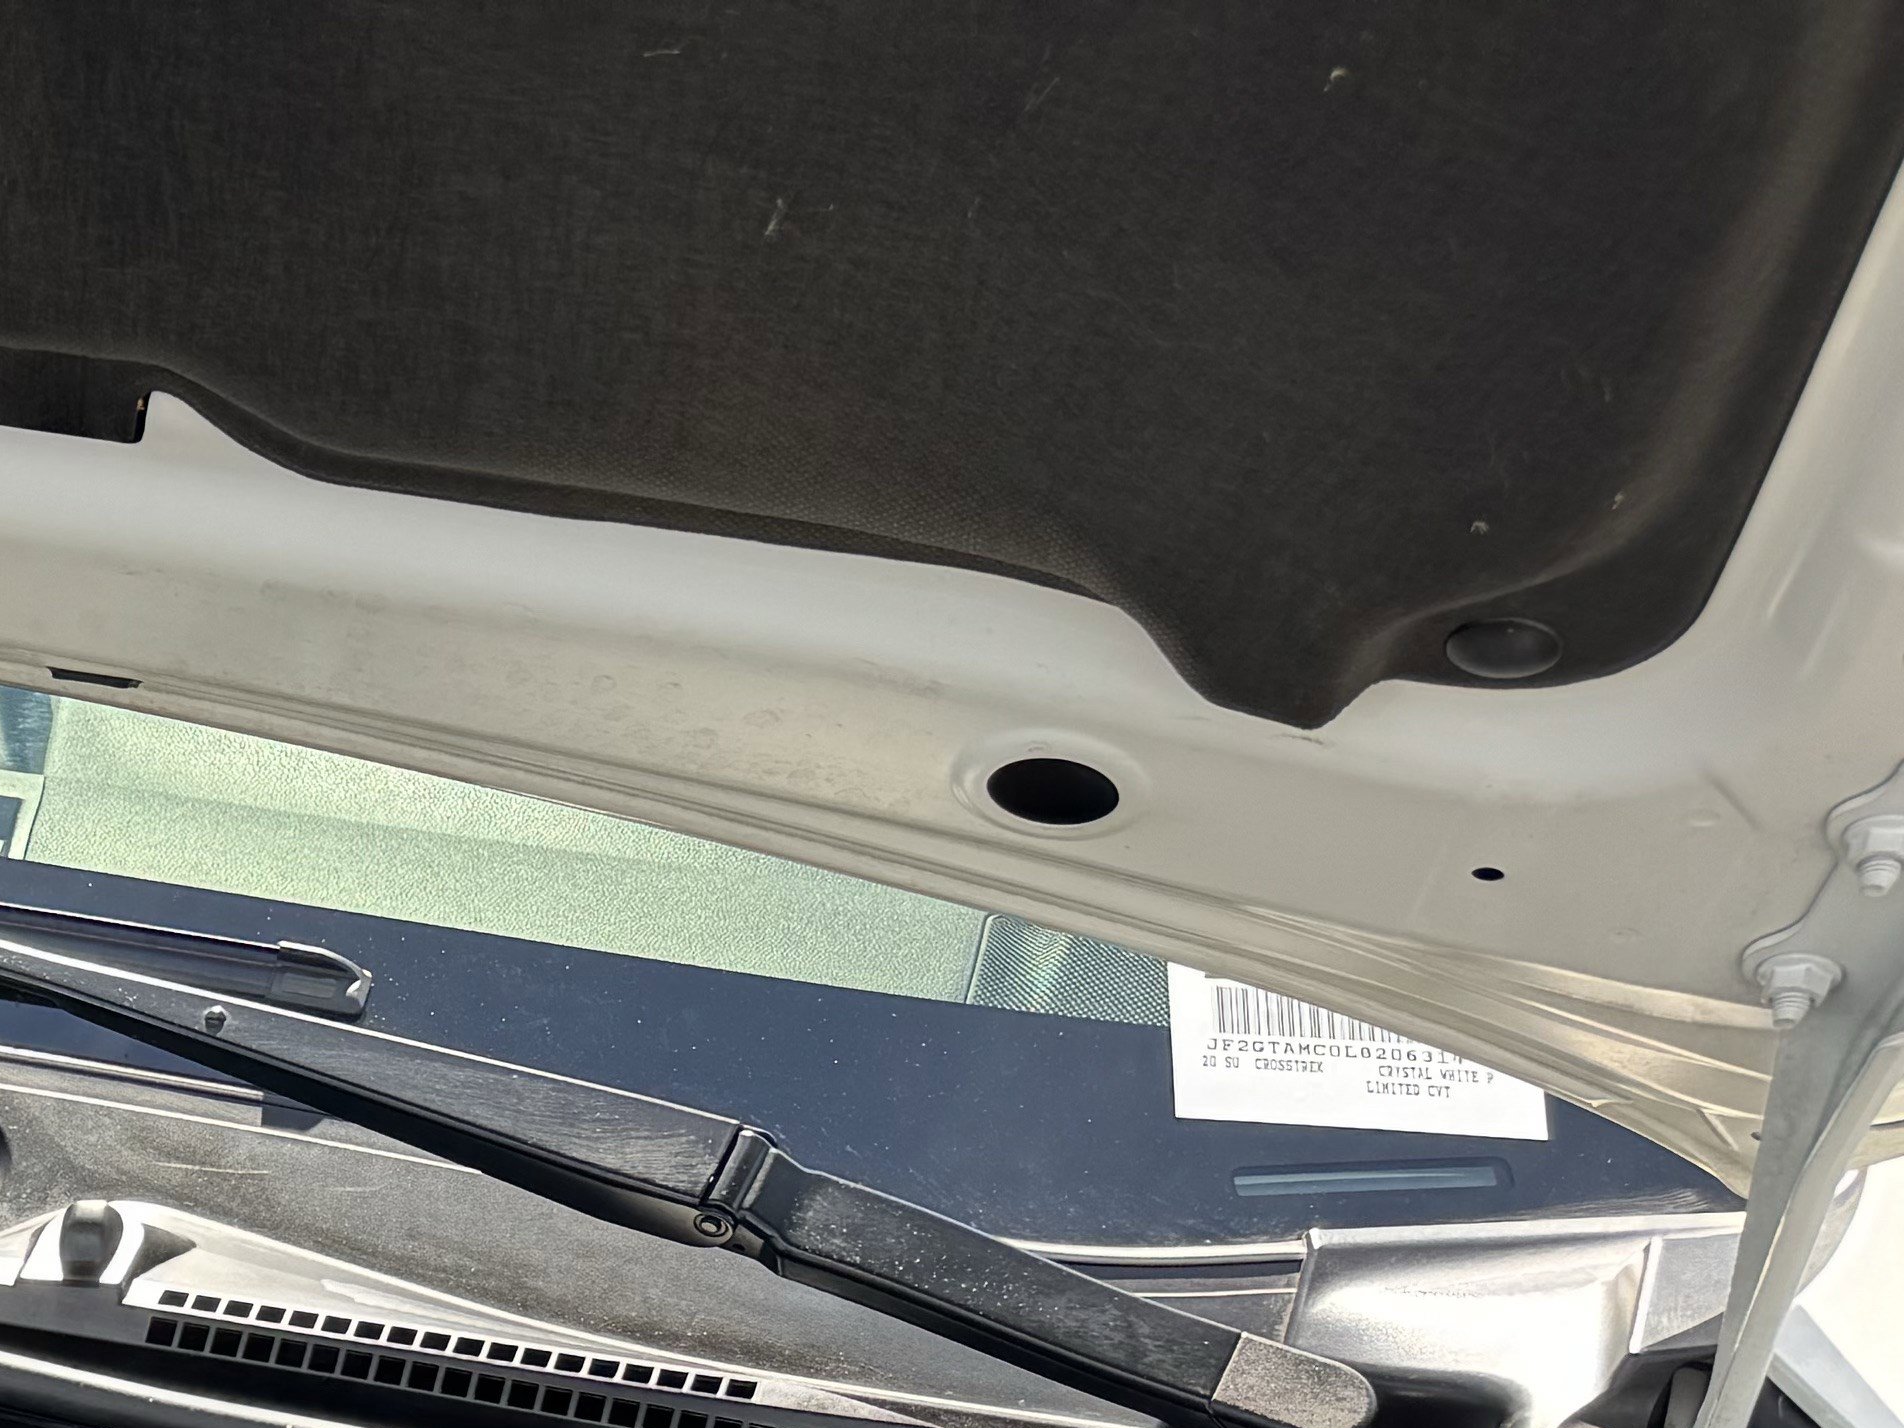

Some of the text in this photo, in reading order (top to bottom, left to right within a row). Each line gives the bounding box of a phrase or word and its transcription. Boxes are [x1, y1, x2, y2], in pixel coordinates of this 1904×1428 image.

[1255, 1058, 1324, 1073] CROSSTREK
[1378, 1065, 1433, 1080] CRYSTAL
[1440, 1069, 1479, 1083] WHITE
[1366, 1080, 1451, 1098] LIMITED CVT
